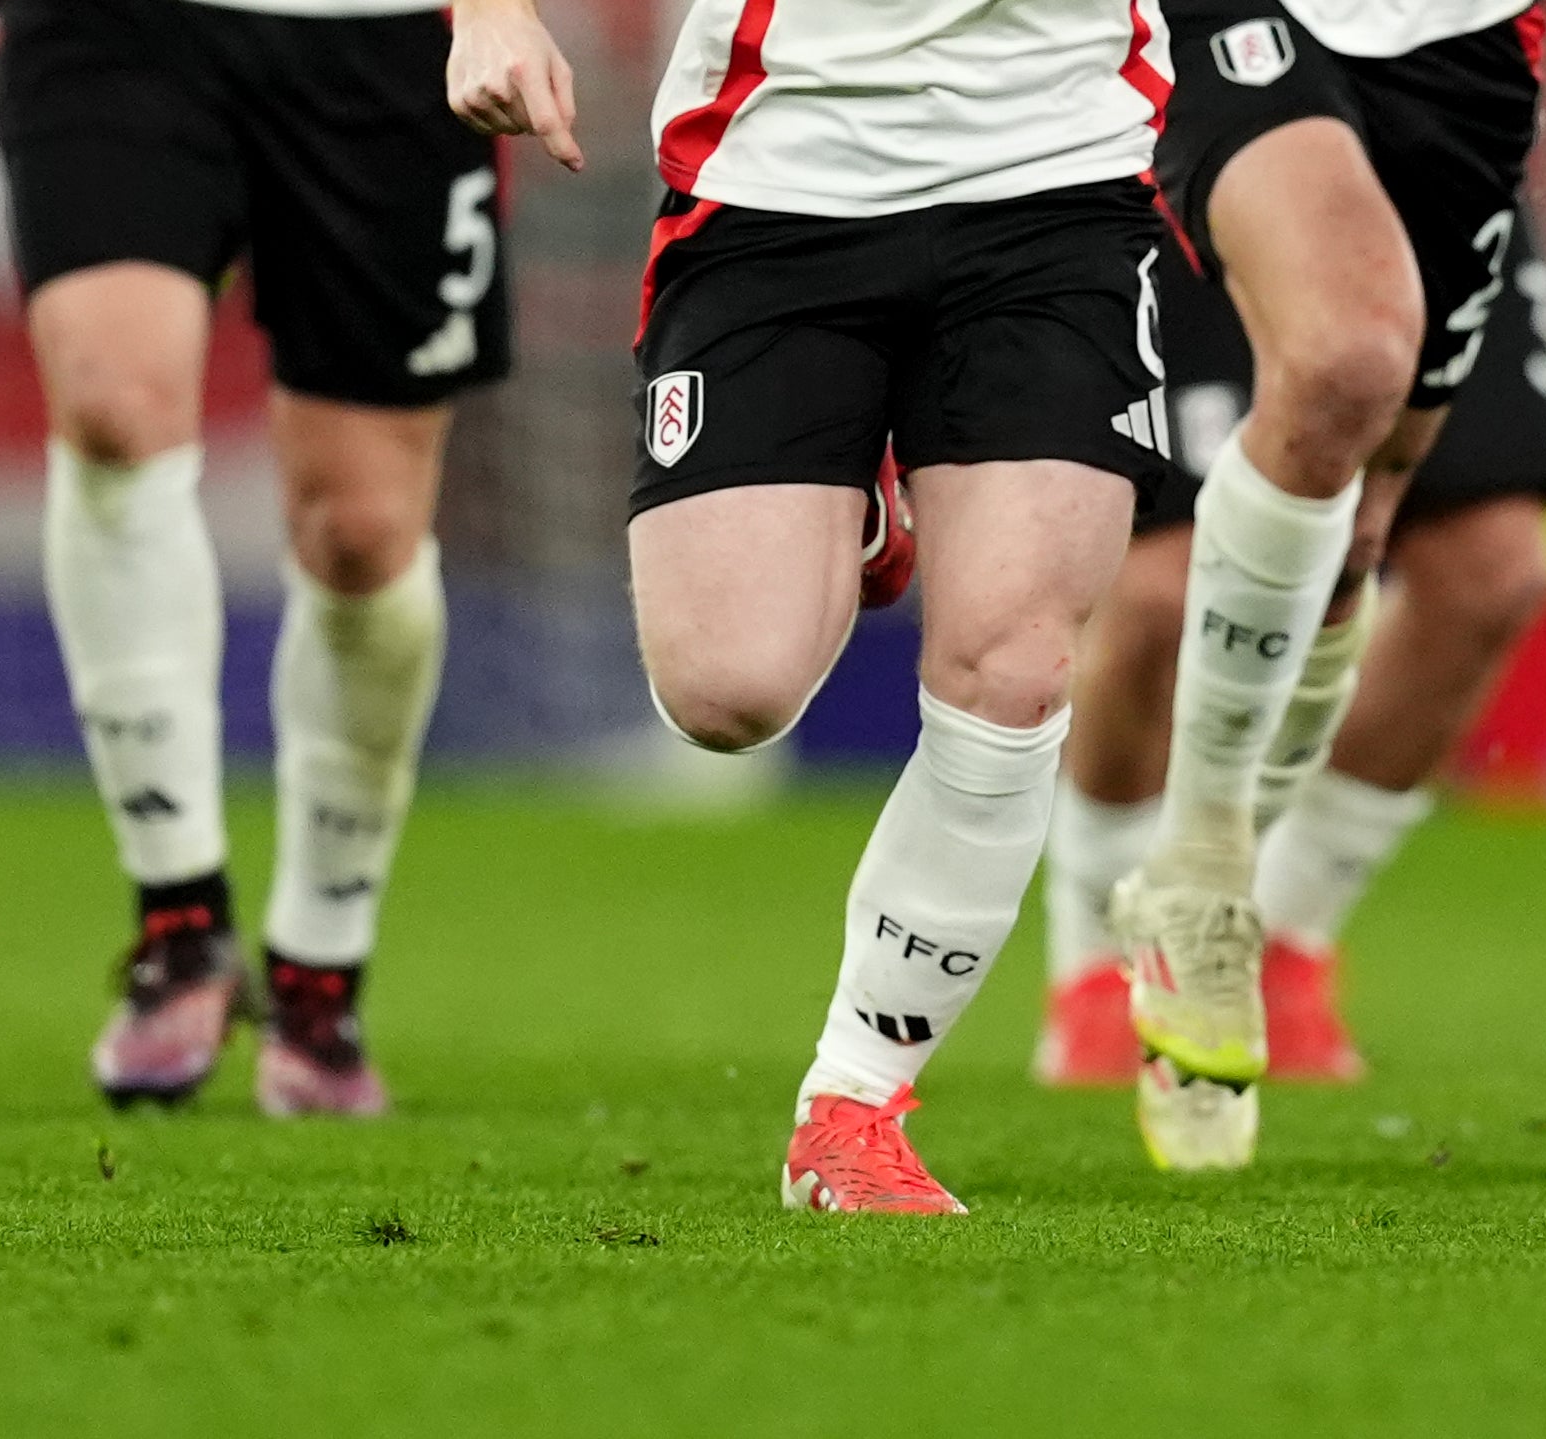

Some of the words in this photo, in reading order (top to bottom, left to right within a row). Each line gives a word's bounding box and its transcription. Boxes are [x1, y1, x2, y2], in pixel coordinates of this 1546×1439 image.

[437, 166, 497, 312] 5
[1202, 609, 1289, 658] FFC
[876, 913, 980, 975] FFC
